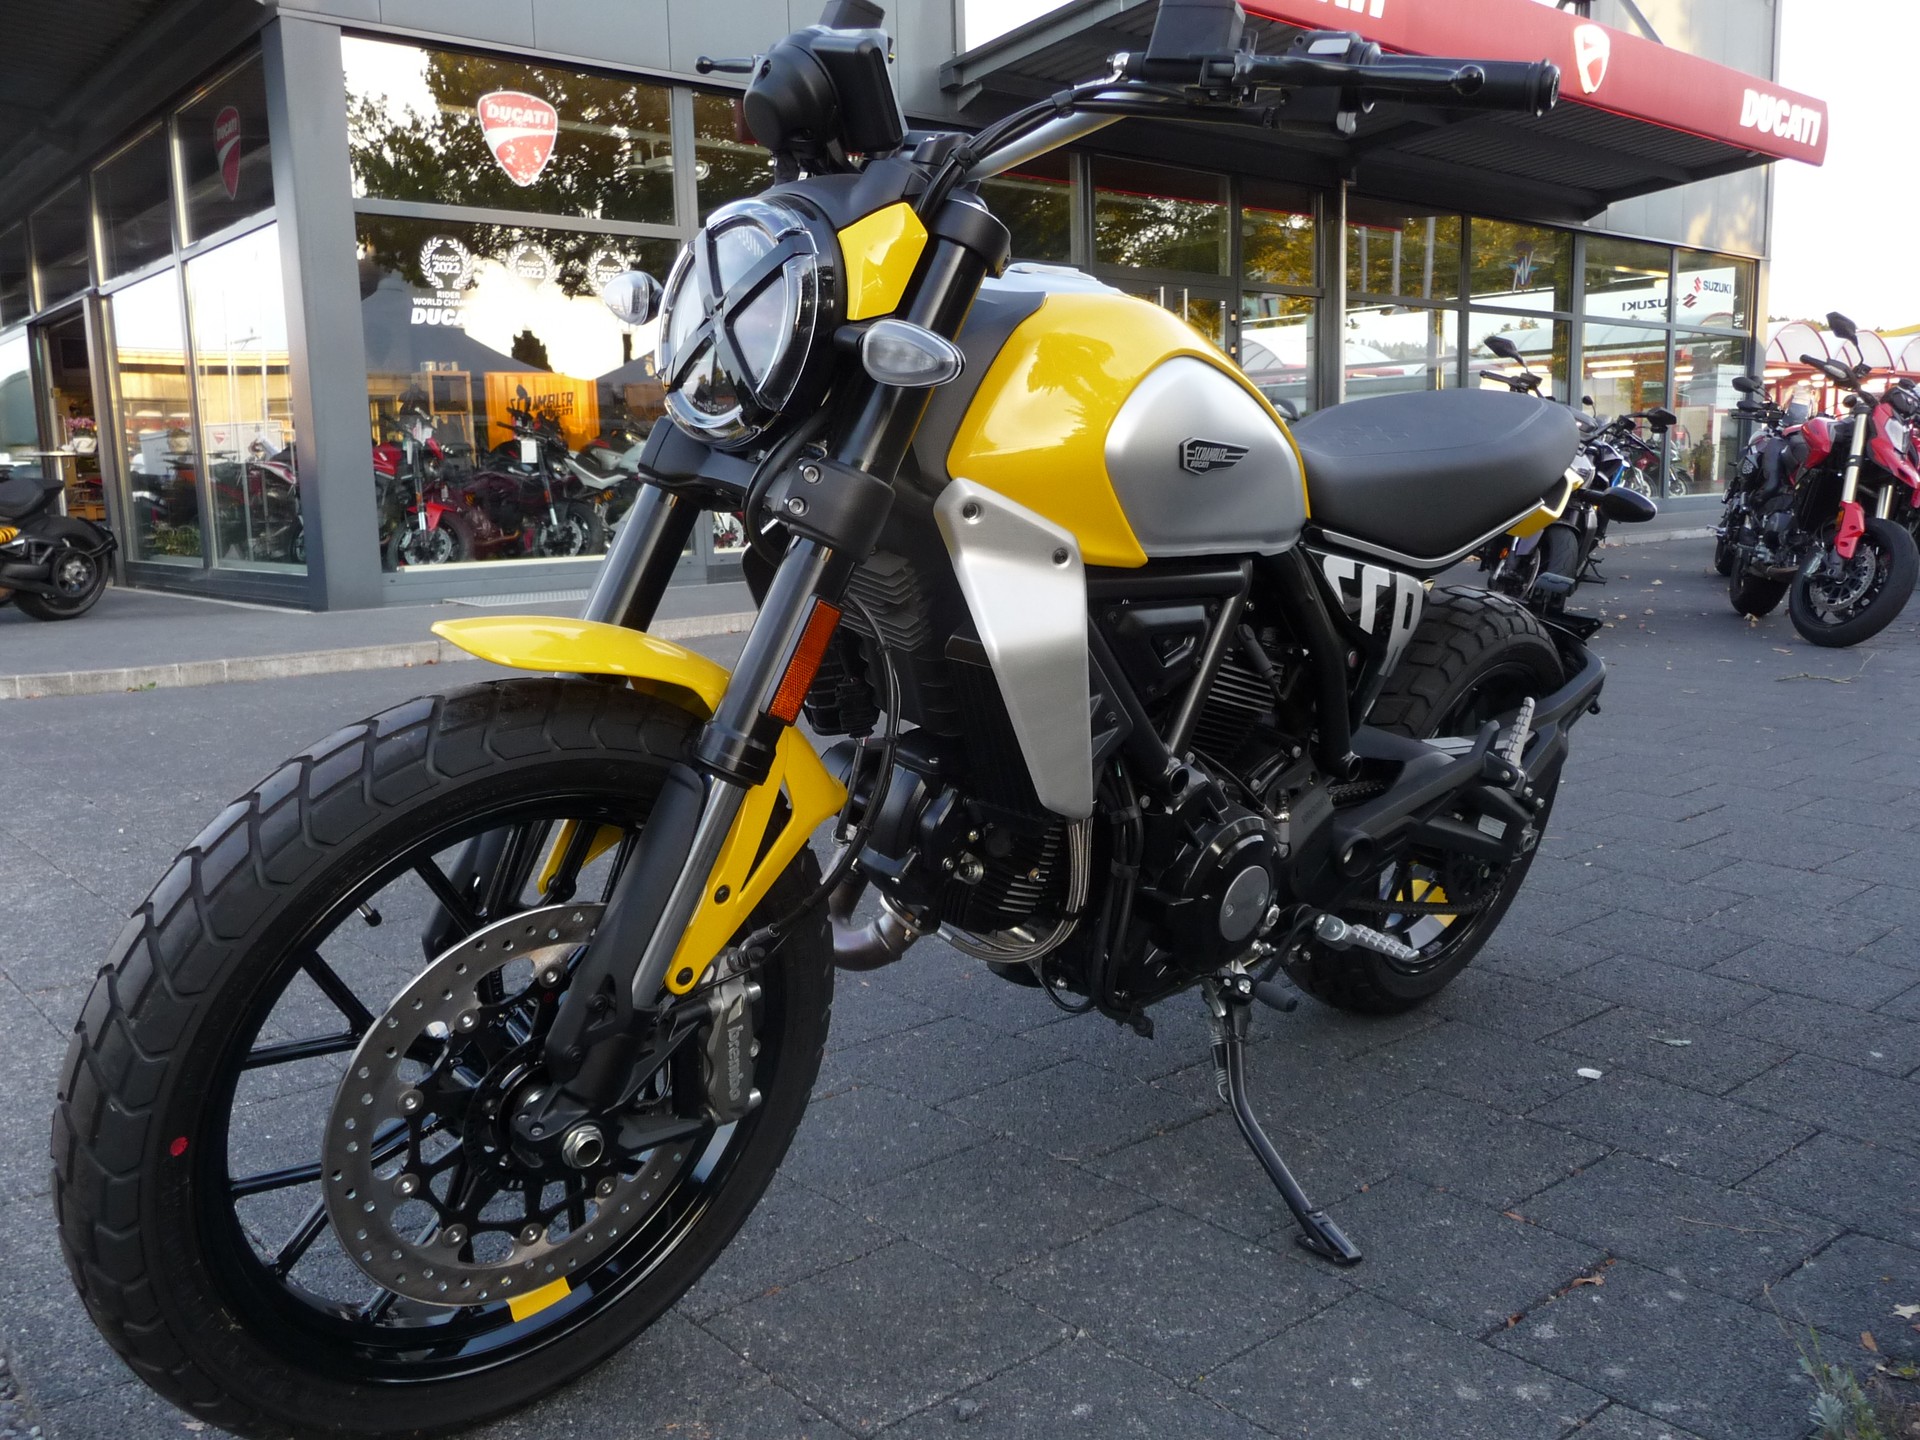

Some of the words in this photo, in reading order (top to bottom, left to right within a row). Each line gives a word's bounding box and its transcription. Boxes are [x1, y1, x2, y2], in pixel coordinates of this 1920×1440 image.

[486, 103, 550, 125] DUCATI
[1740, 88, 1821, 147] DUCATI
[431, 254, 460, 262] MotoGP
[517, 259, 544, 267] MotoGP
[431, 261, 461, 274] 2022
[518, 267, 544, 279] 2022
[597, 264, 622, 272] MotoGP
[1703, 280, 1732, 294] SUZUKI
[436, 291, 461, 299] RIDER
[412, 298, 443, 306] WORLD
[1194, 446, 1227, 462] SCRAMBLER
[1190, 460, 1210, 468] DUCATI
[727, 1024, 744, 1101] brembo
